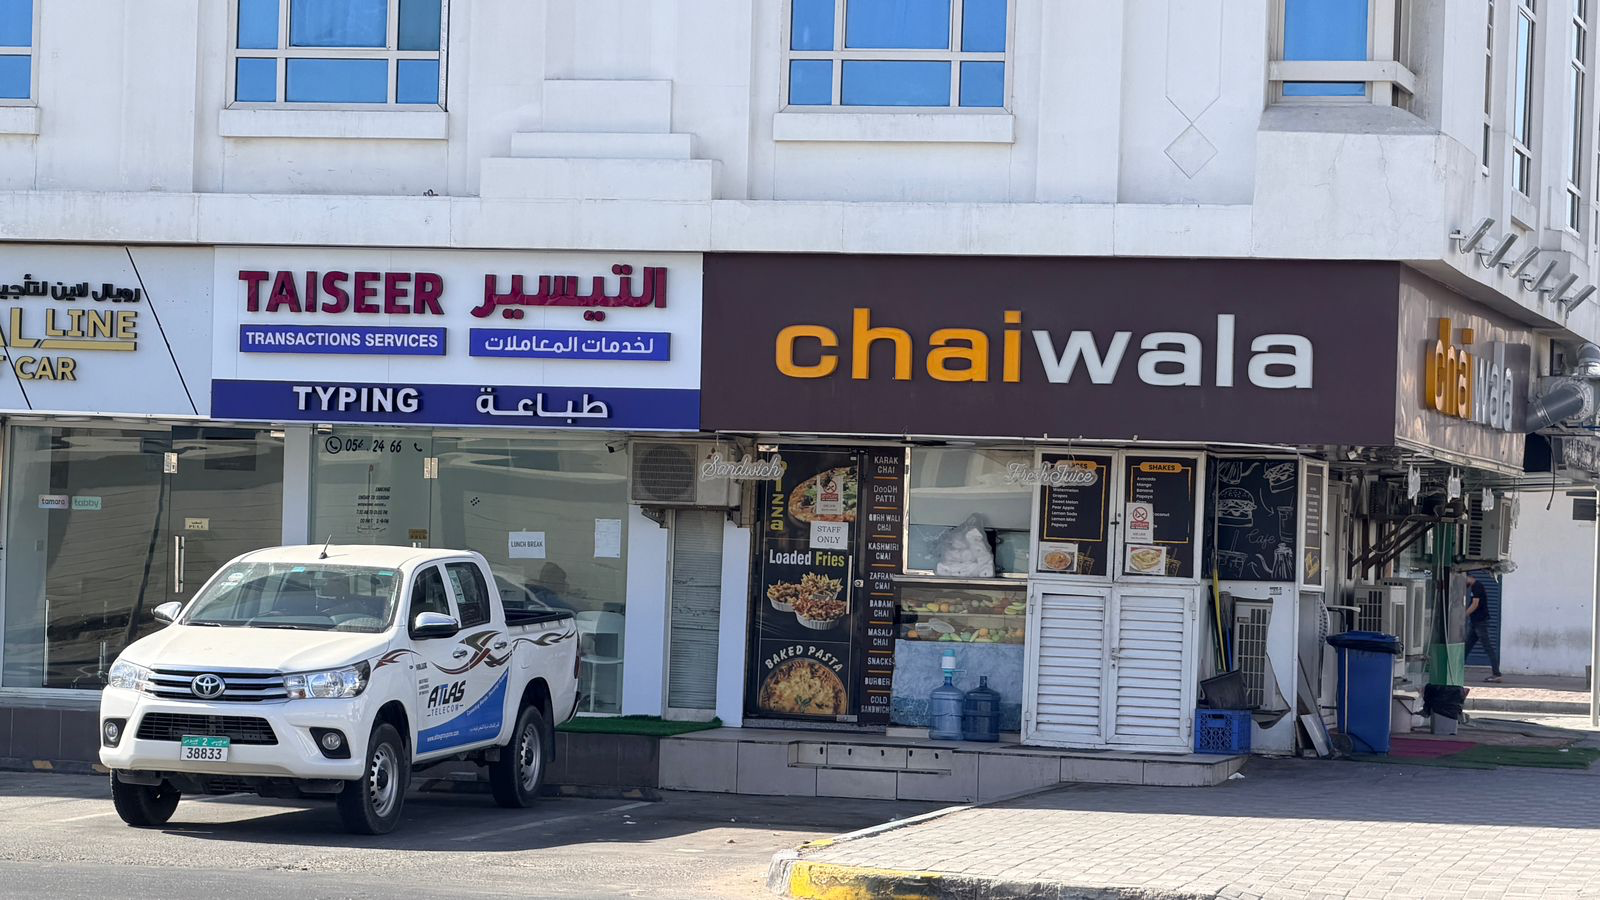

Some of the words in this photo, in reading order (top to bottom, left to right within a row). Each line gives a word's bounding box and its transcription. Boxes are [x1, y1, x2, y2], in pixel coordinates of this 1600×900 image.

[0, 273, 48, 299] لتأجي
[51, 281, 89, 300] لاين
[92, 283, 141, 302] رويال
[239, 270, 444, 315] TAISEER
[470, 264, 668, 321] التيسير
[46, 308, 137, 339] LINE
[246, 332, 361, 346] TRANSACTIONS
[365, 333, 438, 347] SERVICES
[484, 335, 578, 353] المعاملات
[582, 336, 654, 354] لخدمات
[775, 307, 1314, 389] chaiwala
[15, 356, 77, 380] CAR
[293, 386, 419, 413] TYPING
[476, 387, 609, 424] طباعة
[372, 440, 385, 453] 24
[390, 440, 402, 453] 66
[702, 454, 782, 479] Sandwich
[874, 456, 899, 465] KARAK
[877, 466, 895, 474] CHAI
[1005, 462, 1050, 484] Fresh
[1049, 464, 1094, 484] Juice
[74, 497, 99, 507] tabby
[875, 494, 896, 503] PATTI
[886, 514, 901, 522] WALI
[817, 525, 841, 534] STAFF
[877, 523, 892, 531] CHAI
[817, 536, 840, 544] ONLY
[868, 542, 899, 551] KASHMIRI
[769, 549, 812, 565] Loaded
[815, 551, 845, 567] Fries
[875, 552, 891, 560] CHAI
[874, 581, 891, 590] CHAI
[873, 609, 889, 618] CHAI
[872, 638, 889, 646] CHAI
[765, 645, 803, 669] BAKED
[808, 646, 843, 672] PASTA
[867, 657, 892, 665] SNACKS
[864, 677, 891, 686] BURGER
[428, 680, 466, 708] ATLAS
[870, 696, 888, 704] COLD
[202, 737, 208, 746] 2
[186, 747, 222, 760] 38833
